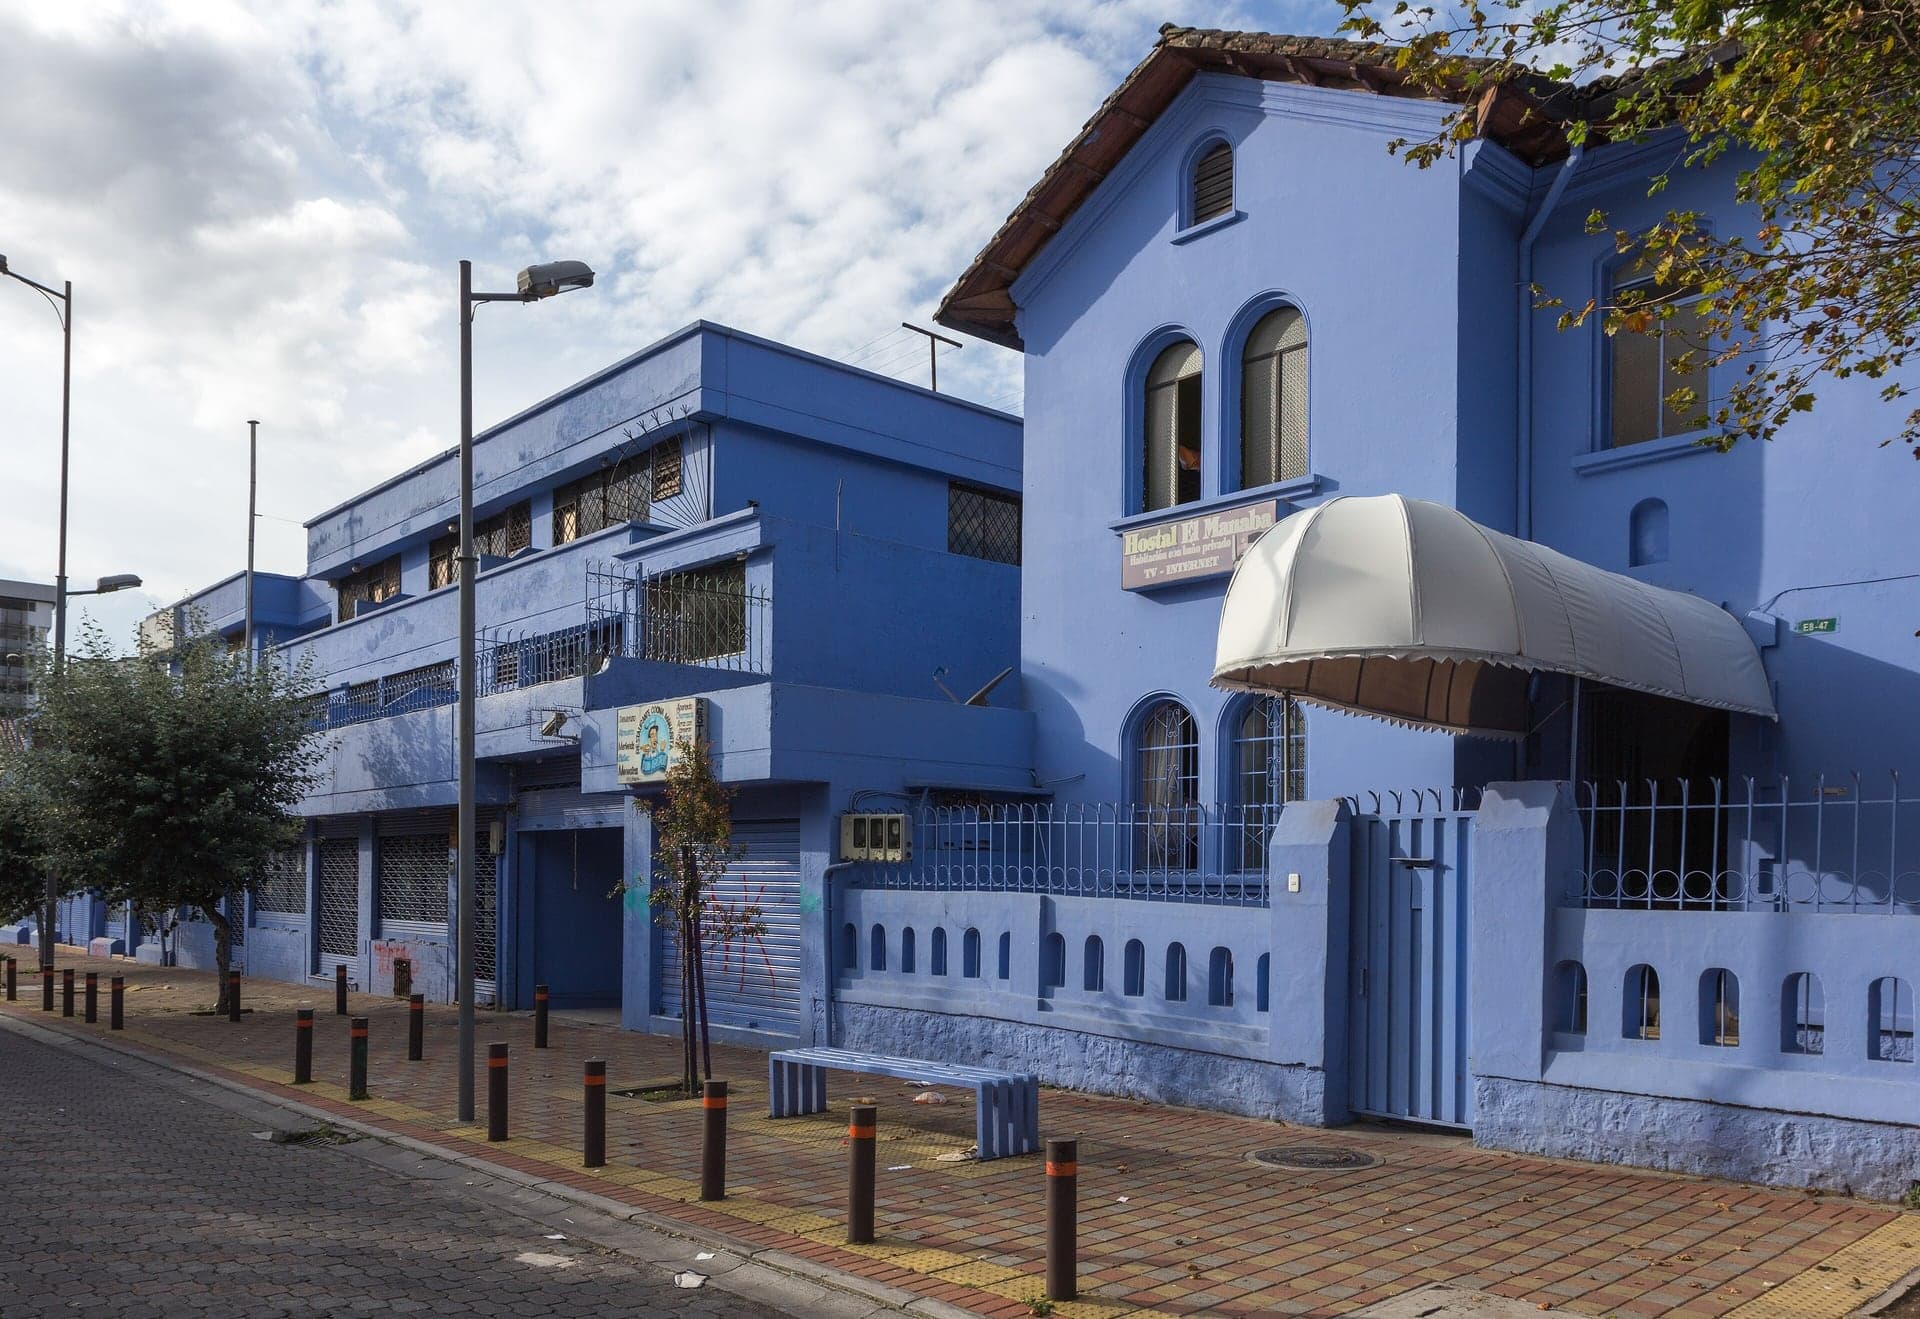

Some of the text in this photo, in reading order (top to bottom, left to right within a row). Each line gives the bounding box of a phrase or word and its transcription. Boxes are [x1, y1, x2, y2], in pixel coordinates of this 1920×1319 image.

[1124, 508, 1272, 555] Hostal El Manaba
[1202, 538, 1232, 555] privado
[1143, 566, 1157, 579] TV
[1166, 556, 1219, 575] INTERNET
